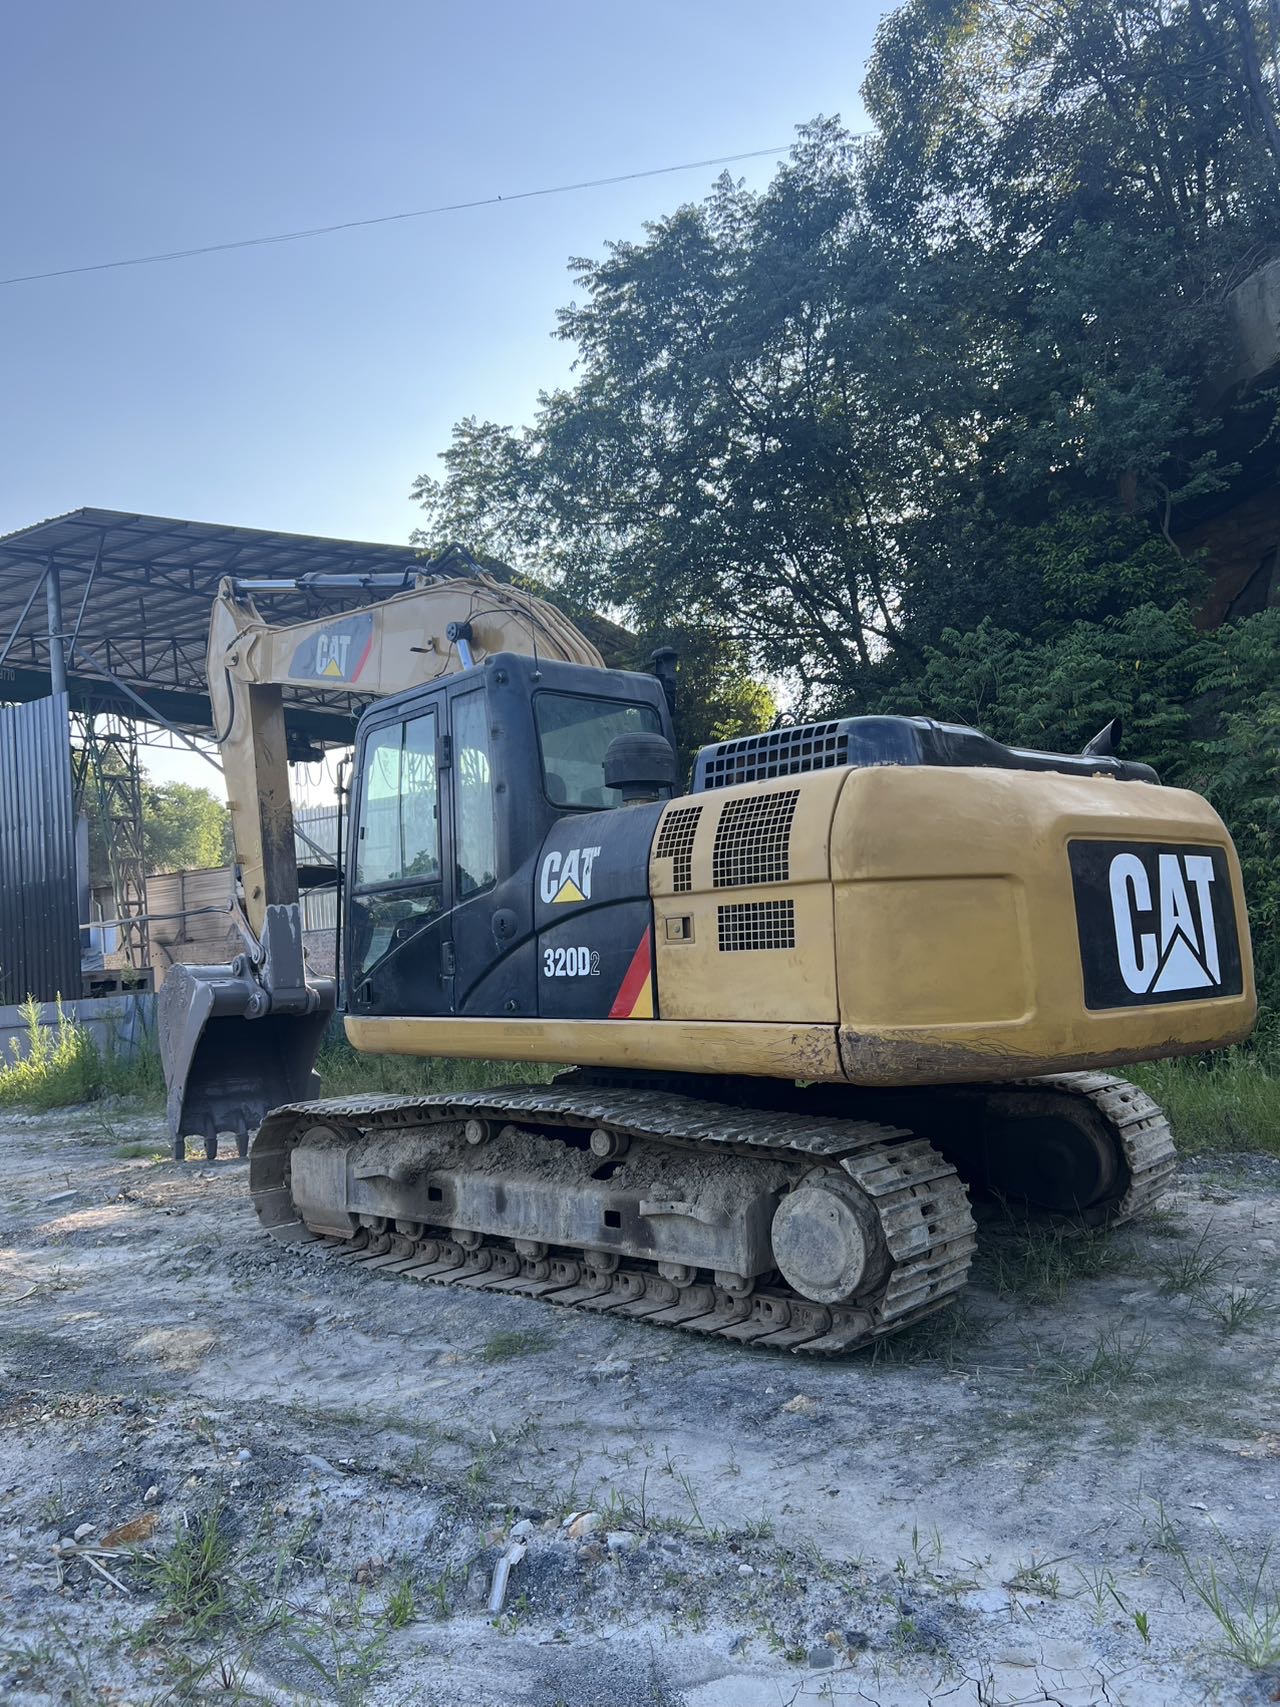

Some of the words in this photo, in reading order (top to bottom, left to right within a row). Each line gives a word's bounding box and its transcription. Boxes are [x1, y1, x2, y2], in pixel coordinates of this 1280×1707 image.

[315, 633, 351, 677] CAT
[541, 847, 601, 903] CAT
[1109, 853, 1221, 993] CAT
[543, 946, 600, 977] 320D2
